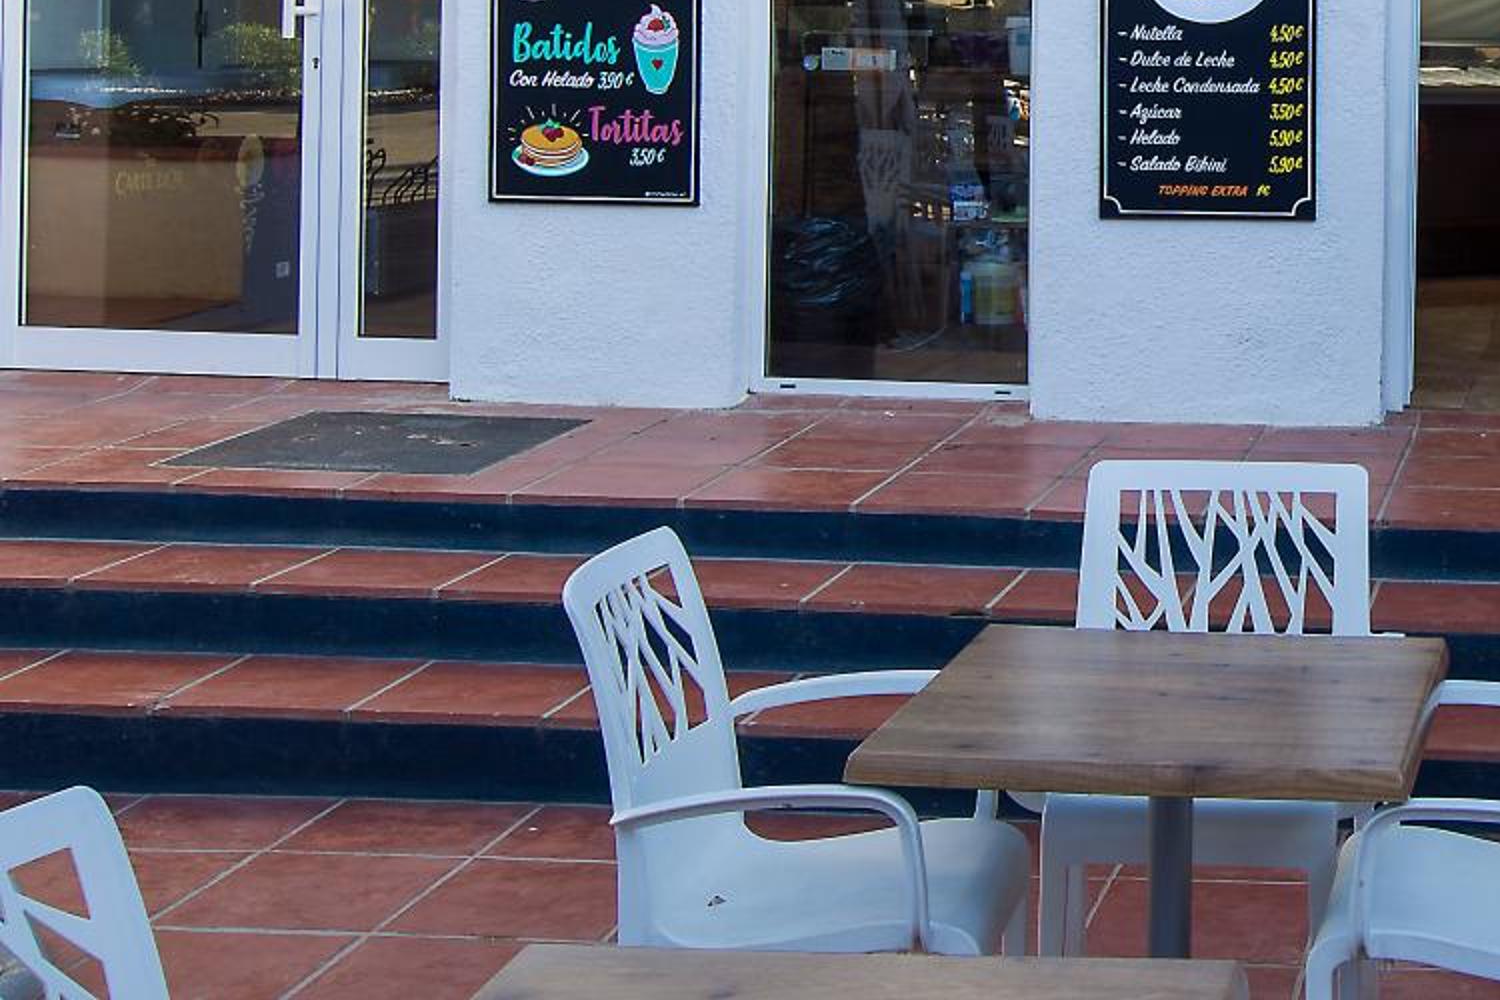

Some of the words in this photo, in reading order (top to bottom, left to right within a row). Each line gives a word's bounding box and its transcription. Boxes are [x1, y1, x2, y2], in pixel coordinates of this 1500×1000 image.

[1130, 24, 1184, 41] Nutella
[513, 21, 620, 65] Batidos
[1130, 49, 1171, 67] Dulce
[1174, 51, 1192, 67] de
[1195, 50, 1235, 68] Leche
[509, 69, 538, 87] Con
[541, 70, 595, 88] Helado
[1130, 76, 1170, 93] Leche
[1173, 77, 1261, 94] Condensada
[1129, 103, 1182, 125] Azúcar
[588, 105, 684, 146] Tortitas
[1130, 128, 1180, 145] Helado
[1129, 155, 1181, 172] Salado
[1184, 156, 1228, 173] Bikini
[1158, 185, 1209, 196] TOPPING
[1211, 185, 1249, 197] EXTRA
